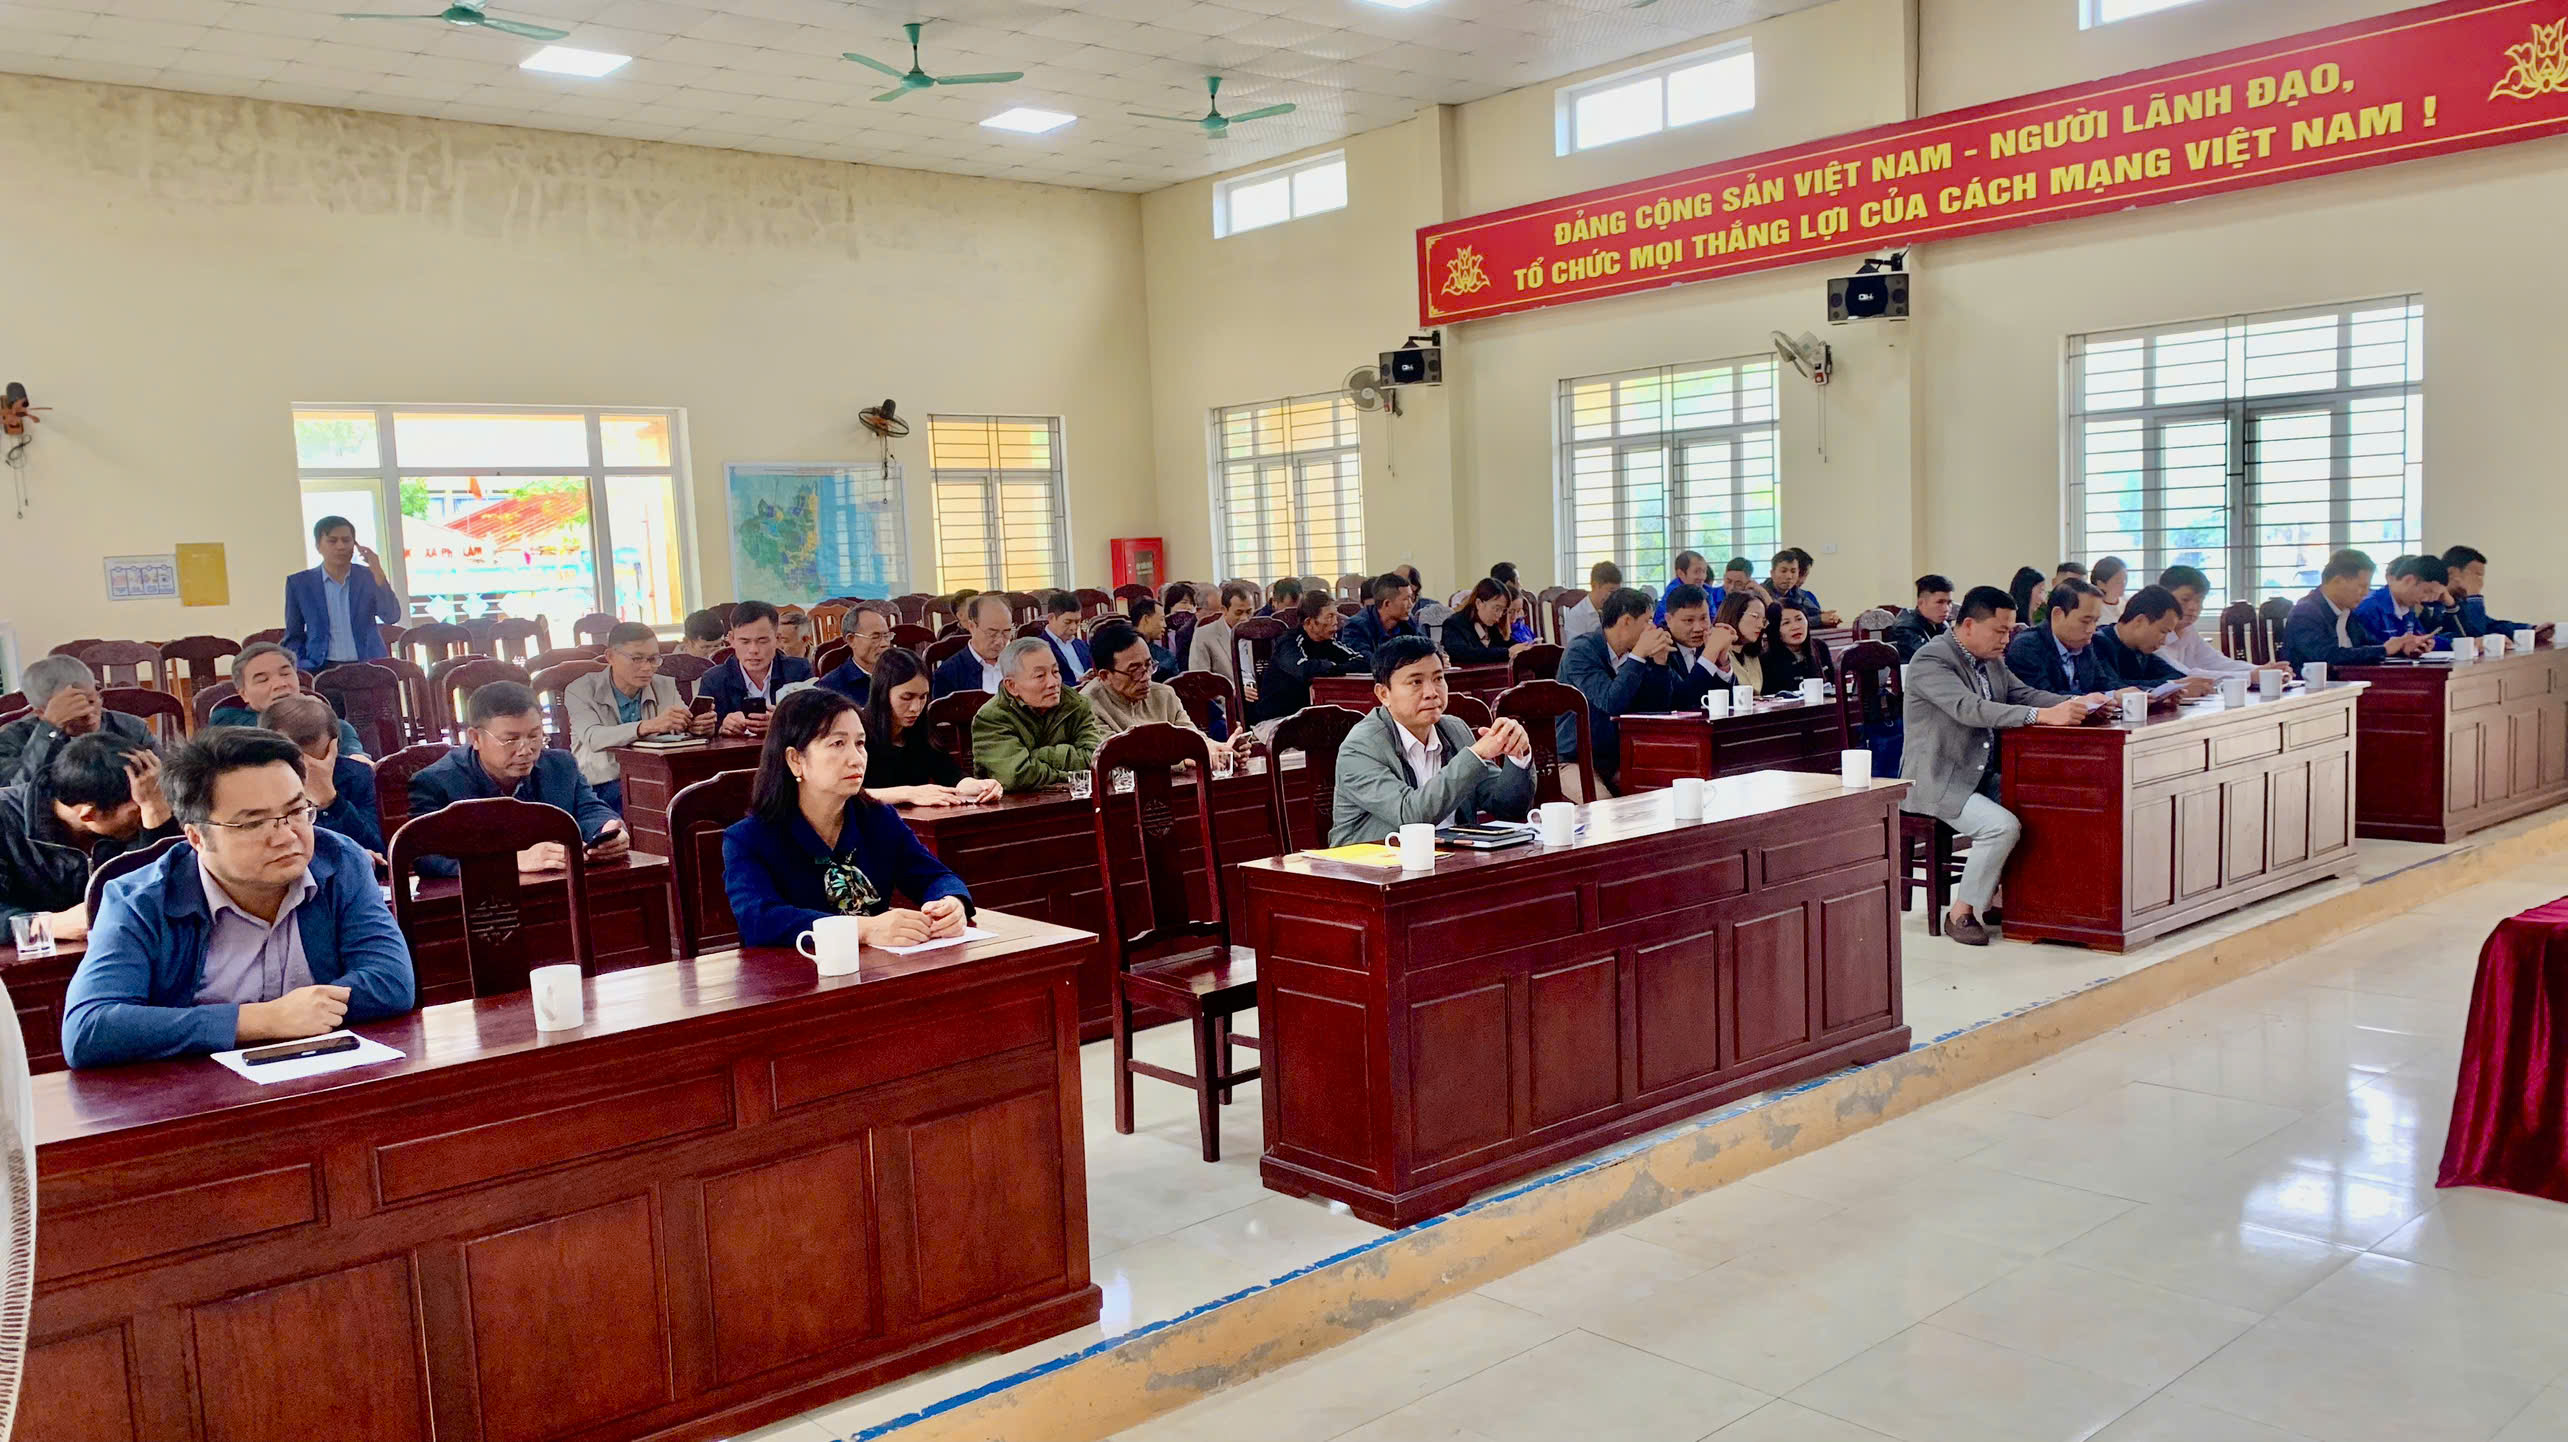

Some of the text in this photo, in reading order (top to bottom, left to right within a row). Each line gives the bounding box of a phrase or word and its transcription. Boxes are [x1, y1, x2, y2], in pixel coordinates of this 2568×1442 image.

[1513, 95, 2438, 291] TỔ CHỨC MỌI THẮNG LỢI CỦA CÁCH MẠNG VIỆT NAM !
[1554, 209, 1627, 246] ĐẢNG
[1635, 193, 1712, 230] CỘNG
[1722, 172, 1784, 213] SẢN
[1793, 160, 1861, 197] VIỆT
[1872, 142, 1952, 182] NAM
[1990, 107, 2108, 160] NGƯỜI
[2122, 85, 2232, 134] LÃNH
[2246, 62, 2354, 108] ĐẠO,
